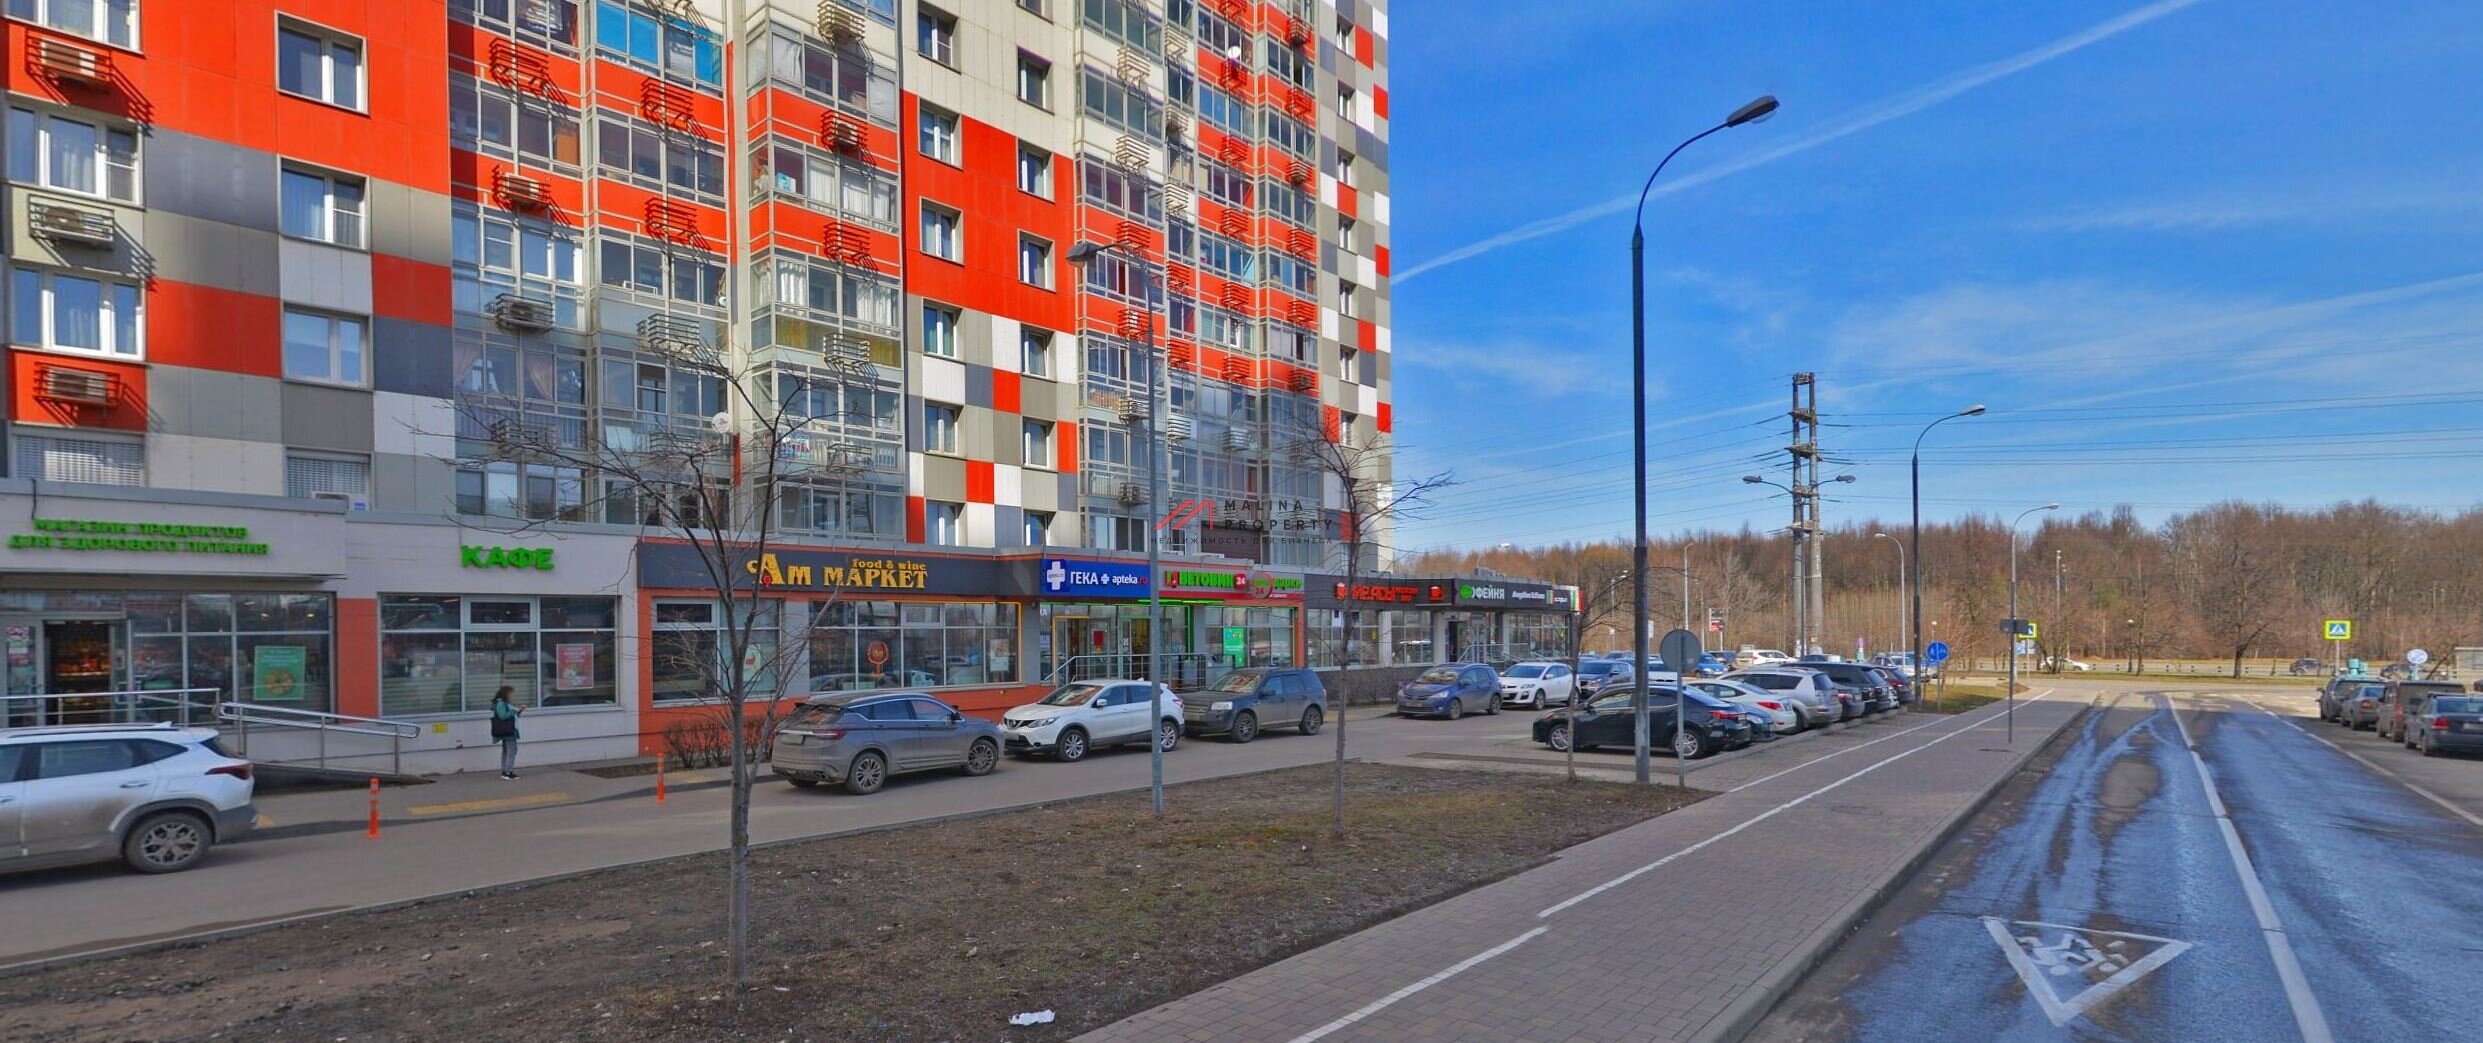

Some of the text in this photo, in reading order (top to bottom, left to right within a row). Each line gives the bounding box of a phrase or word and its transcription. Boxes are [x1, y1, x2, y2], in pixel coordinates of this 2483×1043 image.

[61, 538, 178, 551] ЗДОРОВОГО
[186, 541, 269, 554] ПИТАНИЯ
[461, 546, 554, 569] КАФЕ
[852, 559, 881, 569] food
[898, 561, 926, 571] wine
